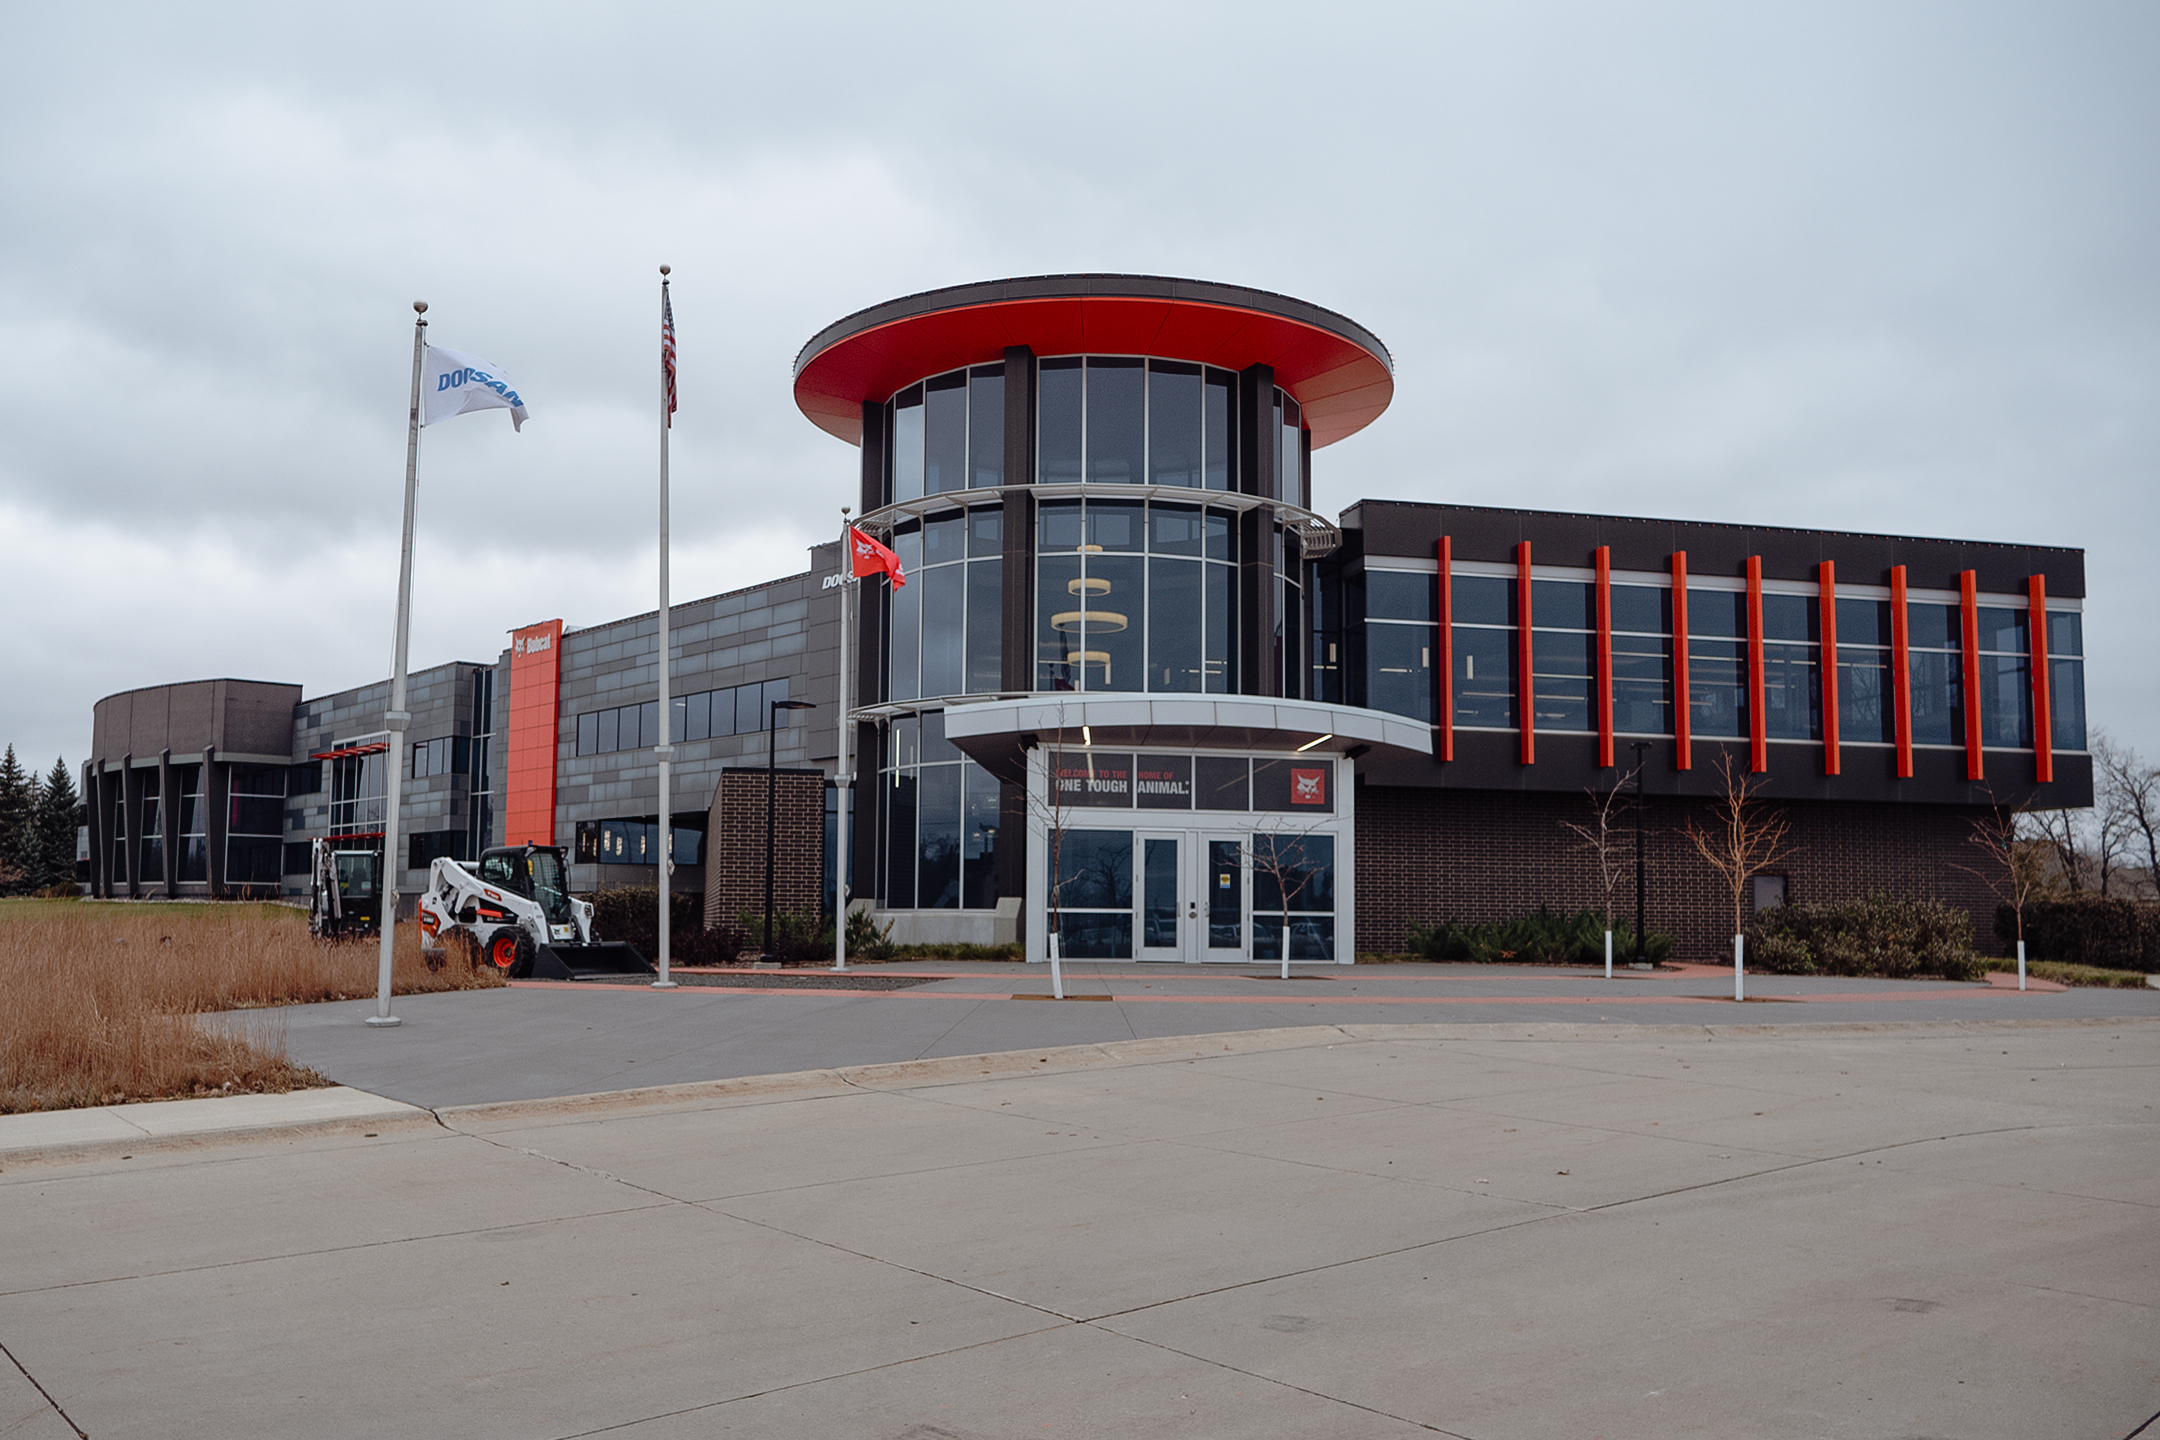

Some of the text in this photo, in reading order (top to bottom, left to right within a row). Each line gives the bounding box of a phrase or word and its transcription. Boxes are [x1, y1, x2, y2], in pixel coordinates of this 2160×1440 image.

[1098, 769, 1110, 779] TO
[1111, 770, 1128, 779] THE
[1137, 771, 1162, 780] HOME
[1163, 771, 1174, 780] OF
[1055, 778, 1082, 792] ONE
[1086, 779, 1128, 794] TOUGH
